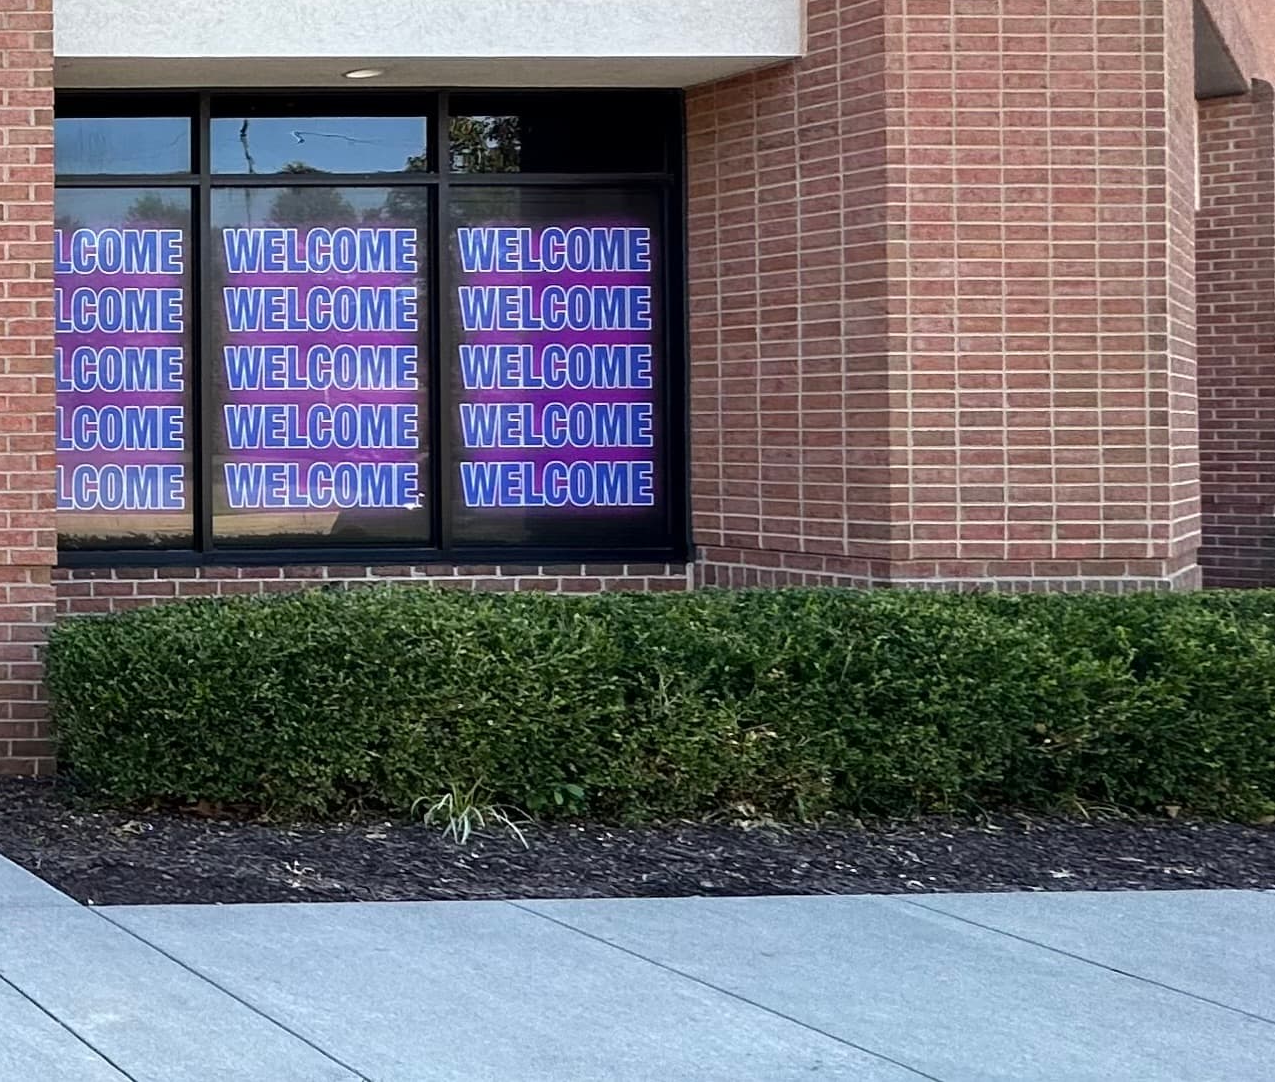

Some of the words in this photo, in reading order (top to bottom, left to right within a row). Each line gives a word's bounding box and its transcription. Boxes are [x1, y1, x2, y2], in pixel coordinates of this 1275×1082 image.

[223, 227, 419, 273] WELCOME
[458, 227, 653, 273] WELCOME
[223, 286, 419, 332] WELCOME
[458, 285, 653, 331] WELCOME
[223, 345, 419, 391] WELCOME
[458, 344, 653, 390] WELCOME
[223, 403, 419, 450] WELCOME
[458, 402, 653, 448] WELCOME
[223, 462, 419, 508] WELCOME
[458, 461, 653, 507] WELCOME
